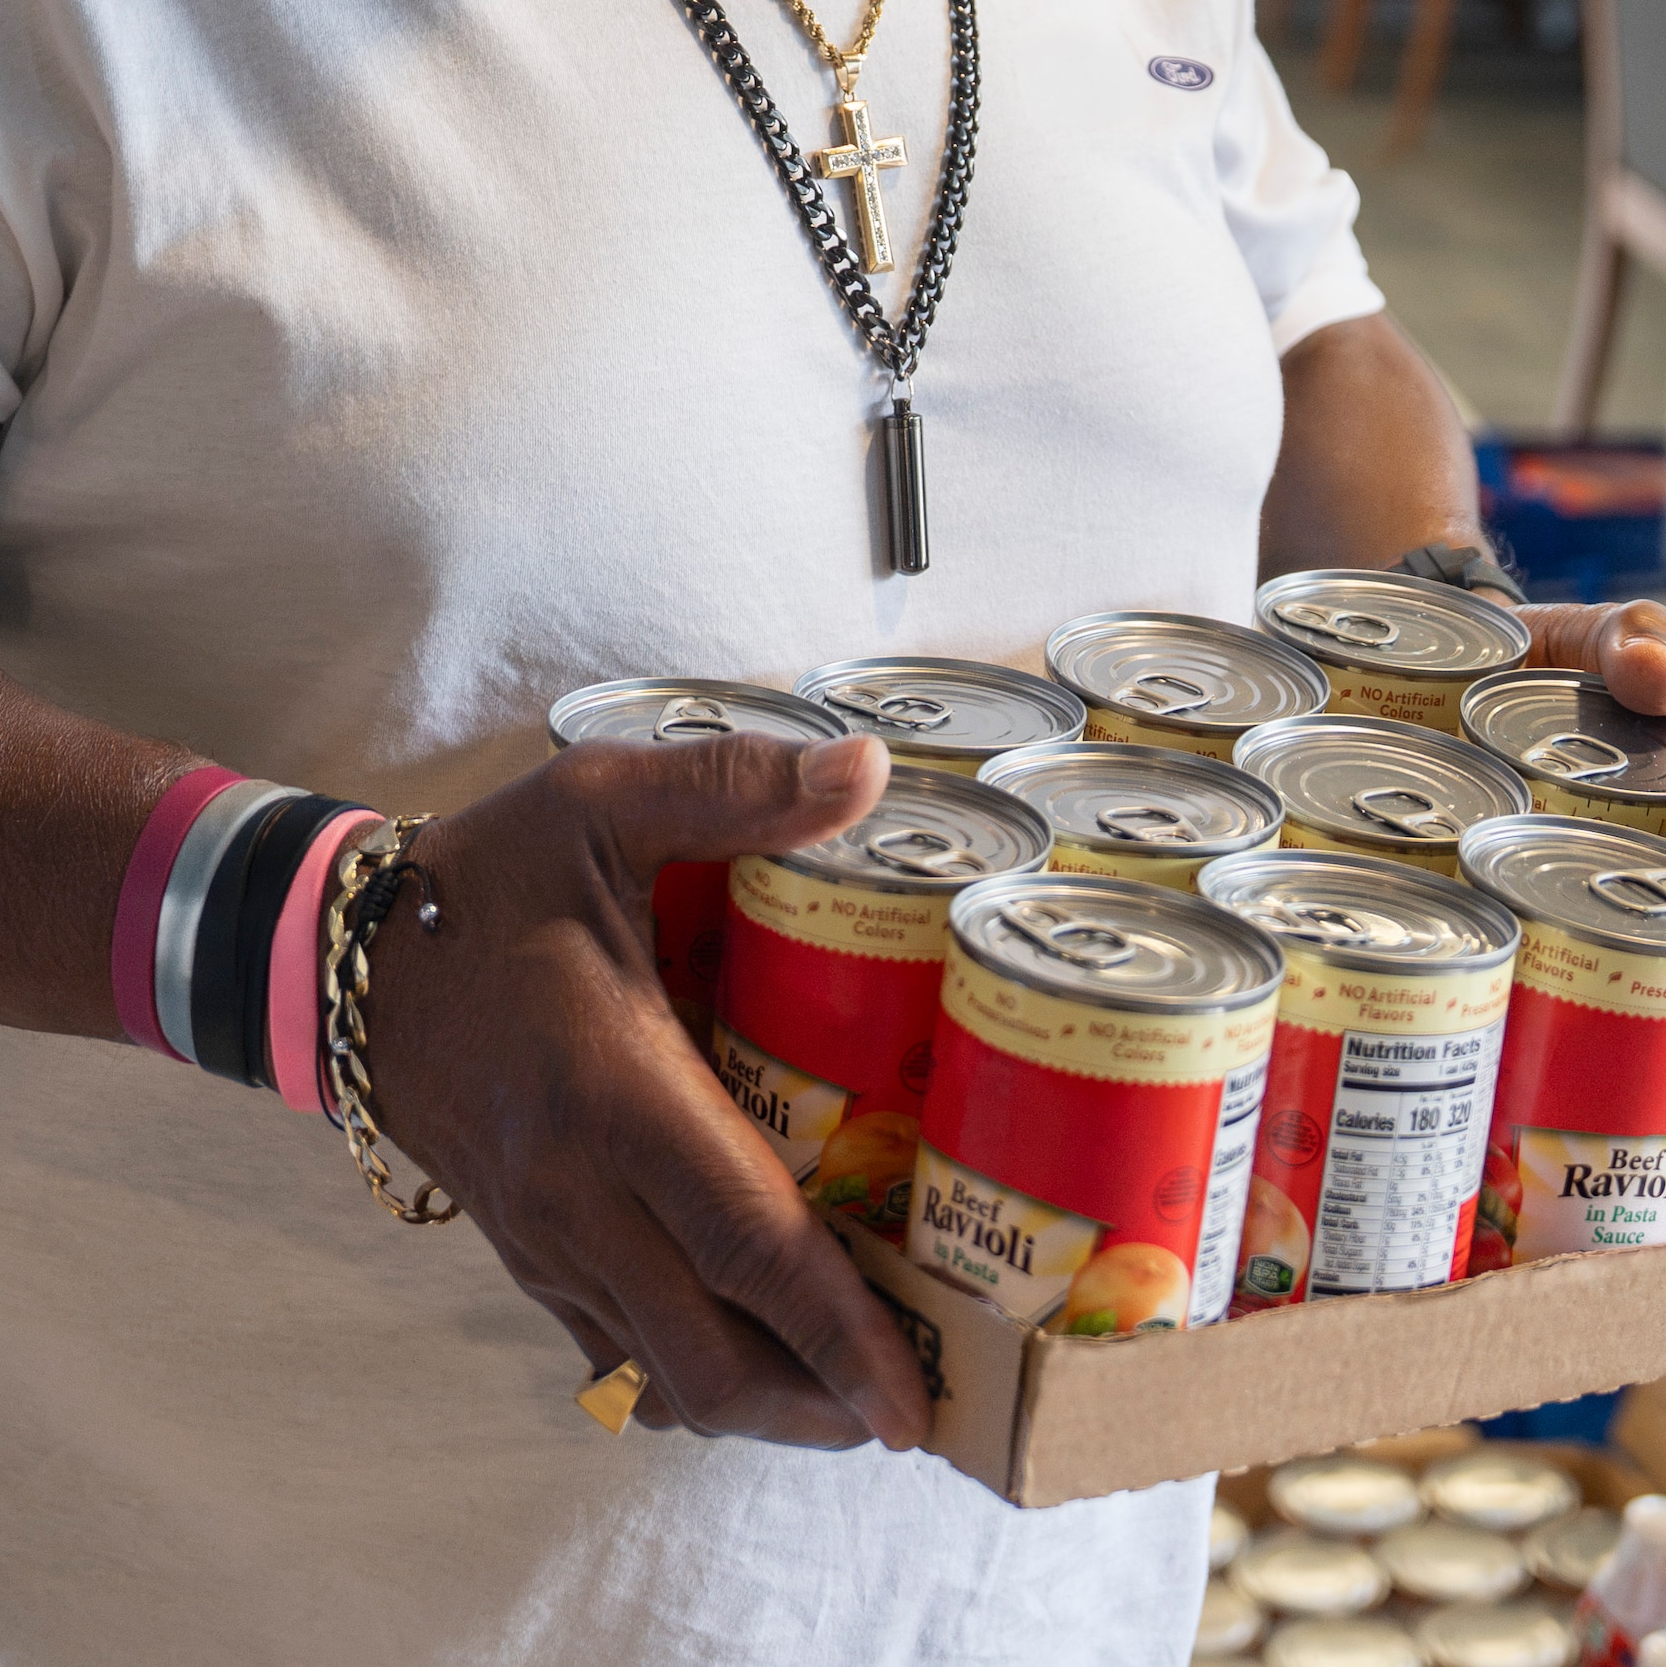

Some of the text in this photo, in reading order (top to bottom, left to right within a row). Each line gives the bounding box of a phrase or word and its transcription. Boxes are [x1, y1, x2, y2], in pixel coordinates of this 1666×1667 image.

[1360, 686, 1446, 707] NO Artificial
[1380, 704, 1424, 721] Colors
[831, 897, 931, 926] NO Artificial
[852, 920, 906, 942] Colors
[1533, 939, 1600, 972] Artificial
[1523, 953, 1575, 982] Flavors
[1339, 983, 1437, 1006] NO Artificial
[1359, 1003, 1414, 1022] Flavors
[1089, 1020, 1117, 1038] NO
[1112, 1041, 1166, 1063] Colors
[1346, 1036, 1482, 1061] Nutrition Facts
[726, 1046, 766, 1090] Beef
[1343, 1060, 1380, 1079] Serving
[1383, 1064, 1401, 1078] size
[1336, 1100, 1472, 1132] Calories 180 320
[1607, 1148, 1666, 1171] Beef
[950, 1178, 1004, 1224] Beef
[1324, 1189, 1367, 1203] Cholesterol
[1585, 1204, 1658, 1224] in Pasta
[922, 1184, 1035, 1276] Ravioli
[1591, 1226, 1645, 1246] Sauce
[933, 1236, 1000, 1287] in Pasta
